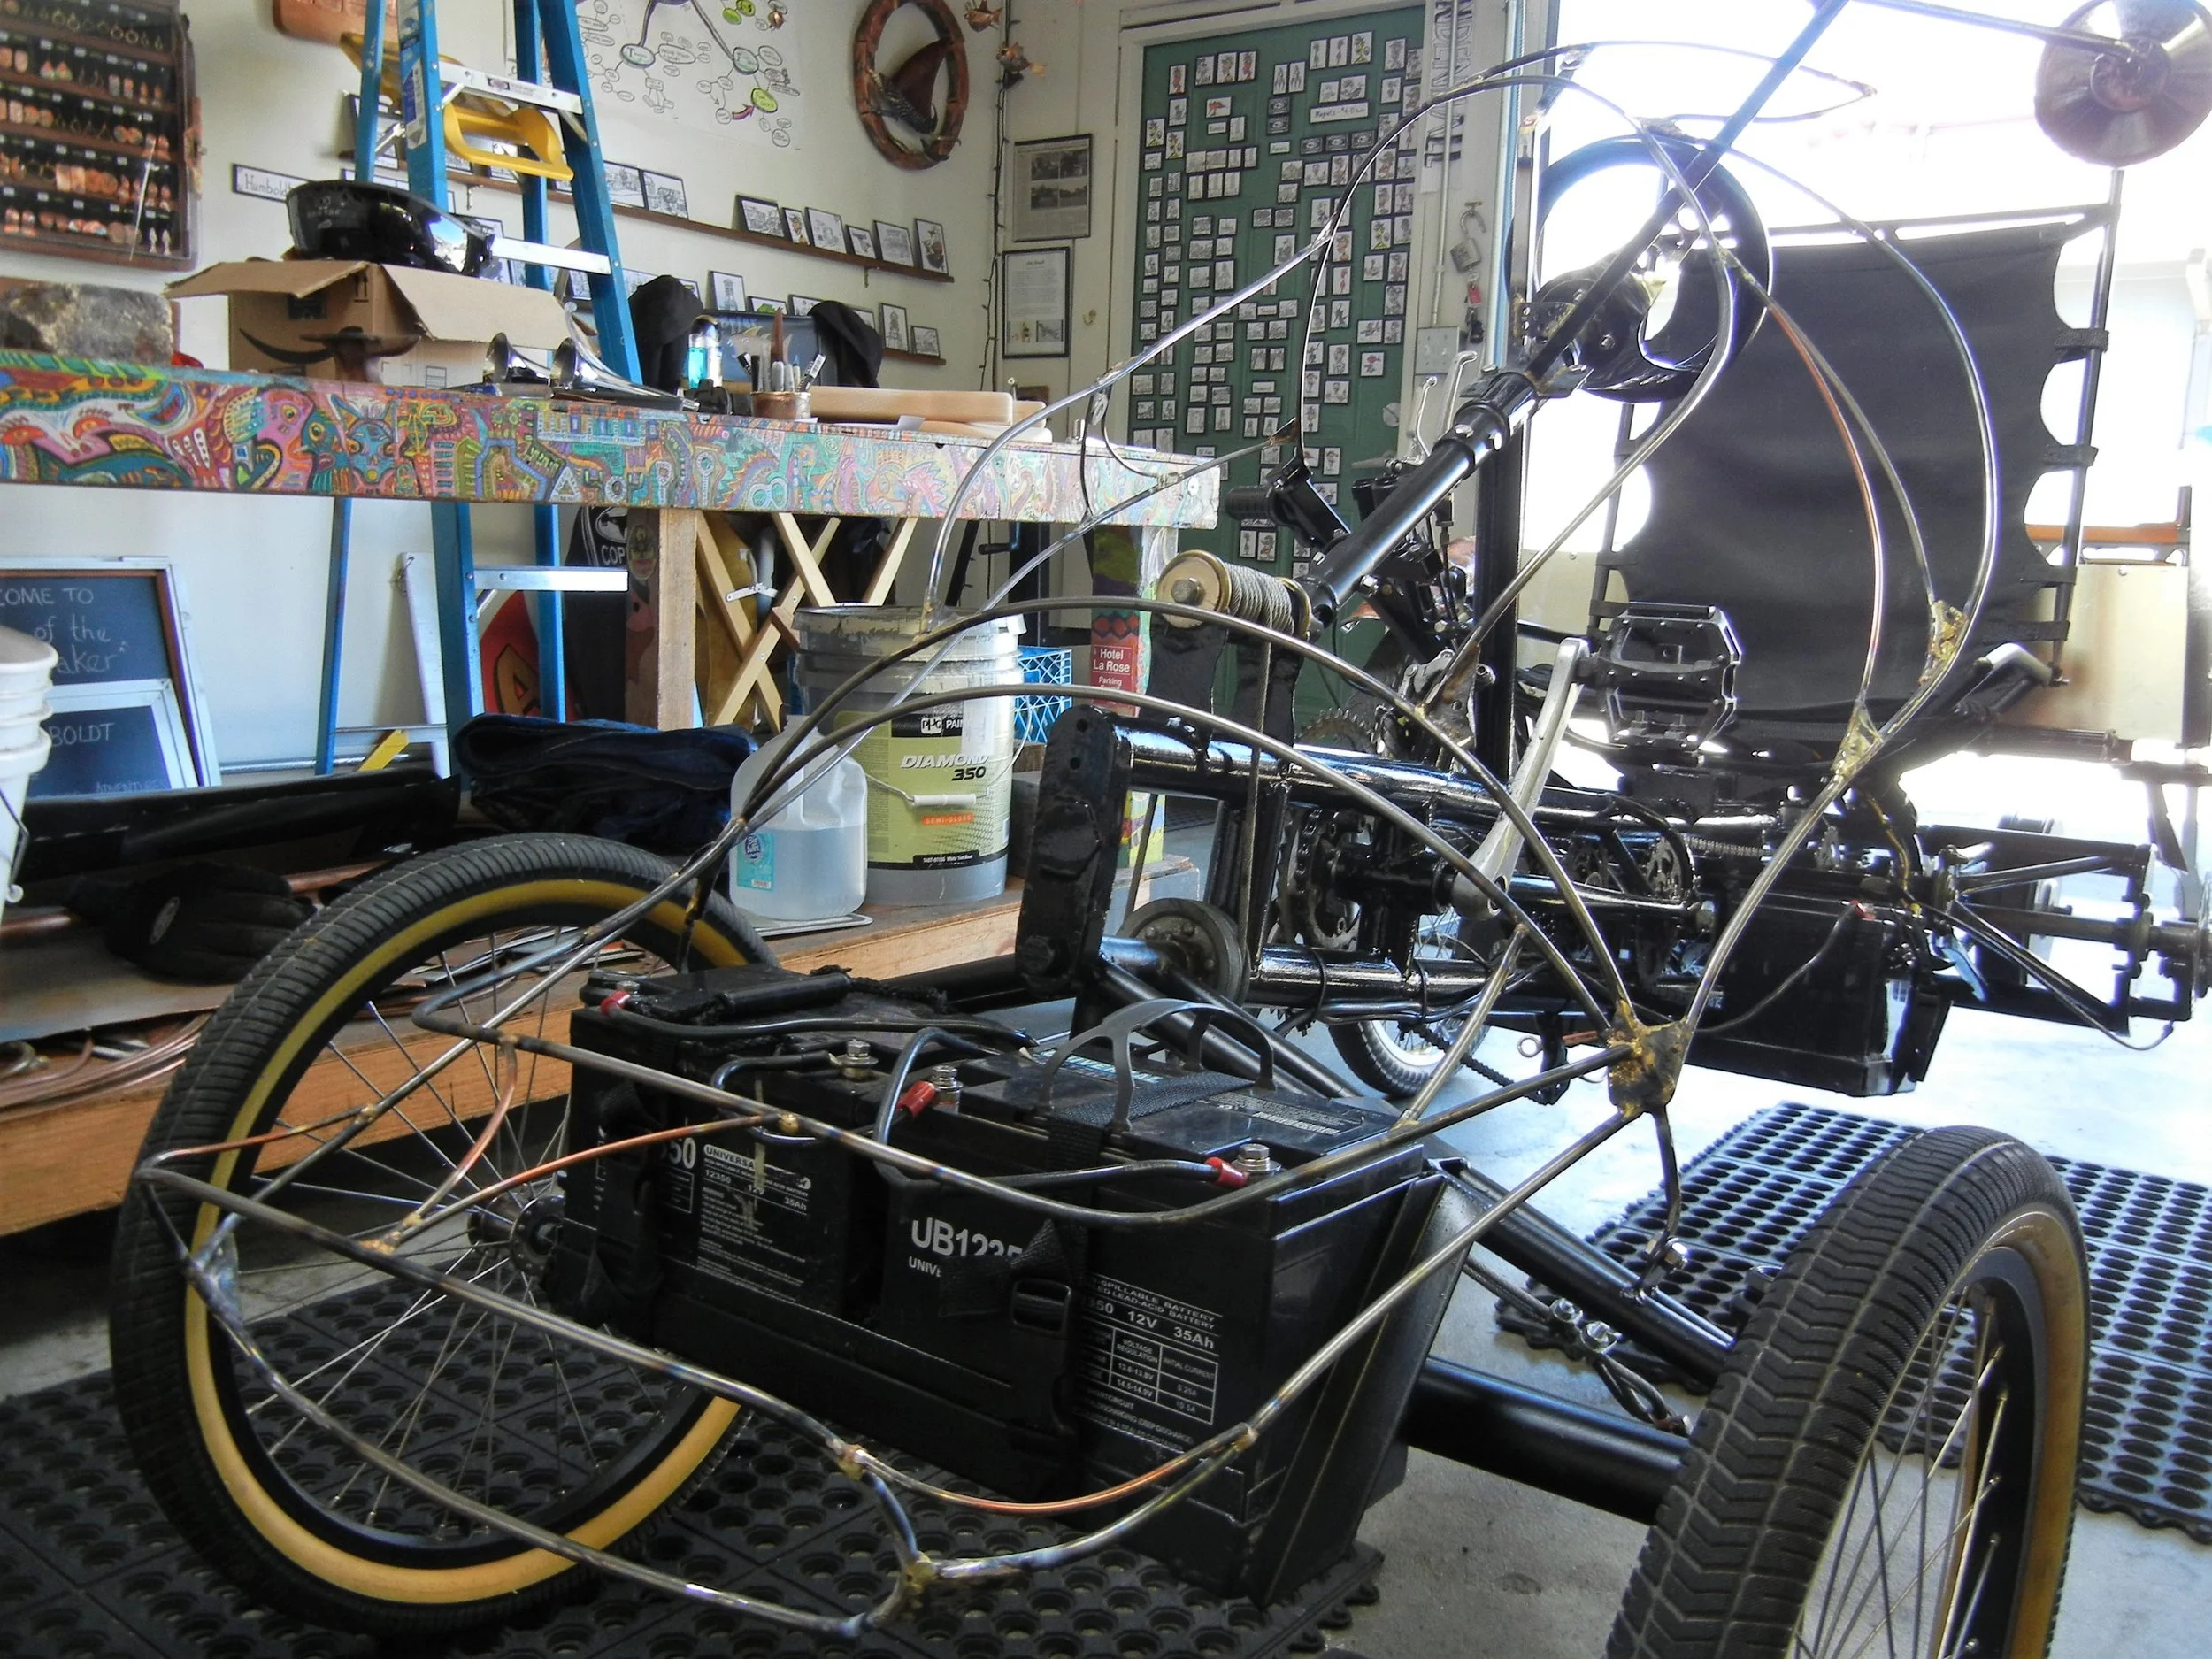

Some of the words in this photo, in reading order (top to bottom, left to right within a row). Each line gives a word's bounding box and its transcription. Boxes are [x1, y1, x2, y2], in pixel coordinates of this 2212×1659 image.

[62, 587, 94, 604] TO
[34, 615, 58, 643] of
[70, 613, 111, 642] the
[1100, 648, 1124, 660] Hotel
[1093, 659, 1104, 671] La
[1106, 660, 1131, 672] Rose
[1098, 675, 1122, 687] Parking
[901, 755, 989, 768] DIAMOND
[951, 766, 987, 781] 350
[924, 814, 972, 825] SEMI-GLOSS
[706, 1146, 756, 1170] UNIVERSA
[784, 1196, 807, 1210] 35Ah
[1112, 1291, 1164, 1313] LEAD-ACID
[1169, 1310, 1215, 1330] BATTERY
[1164, 1302, 1215, 1323] BATTERY
[1127, 1310, 1157, 1329] 12V
[1173, 1326, 1214, 1349] 35Ah
